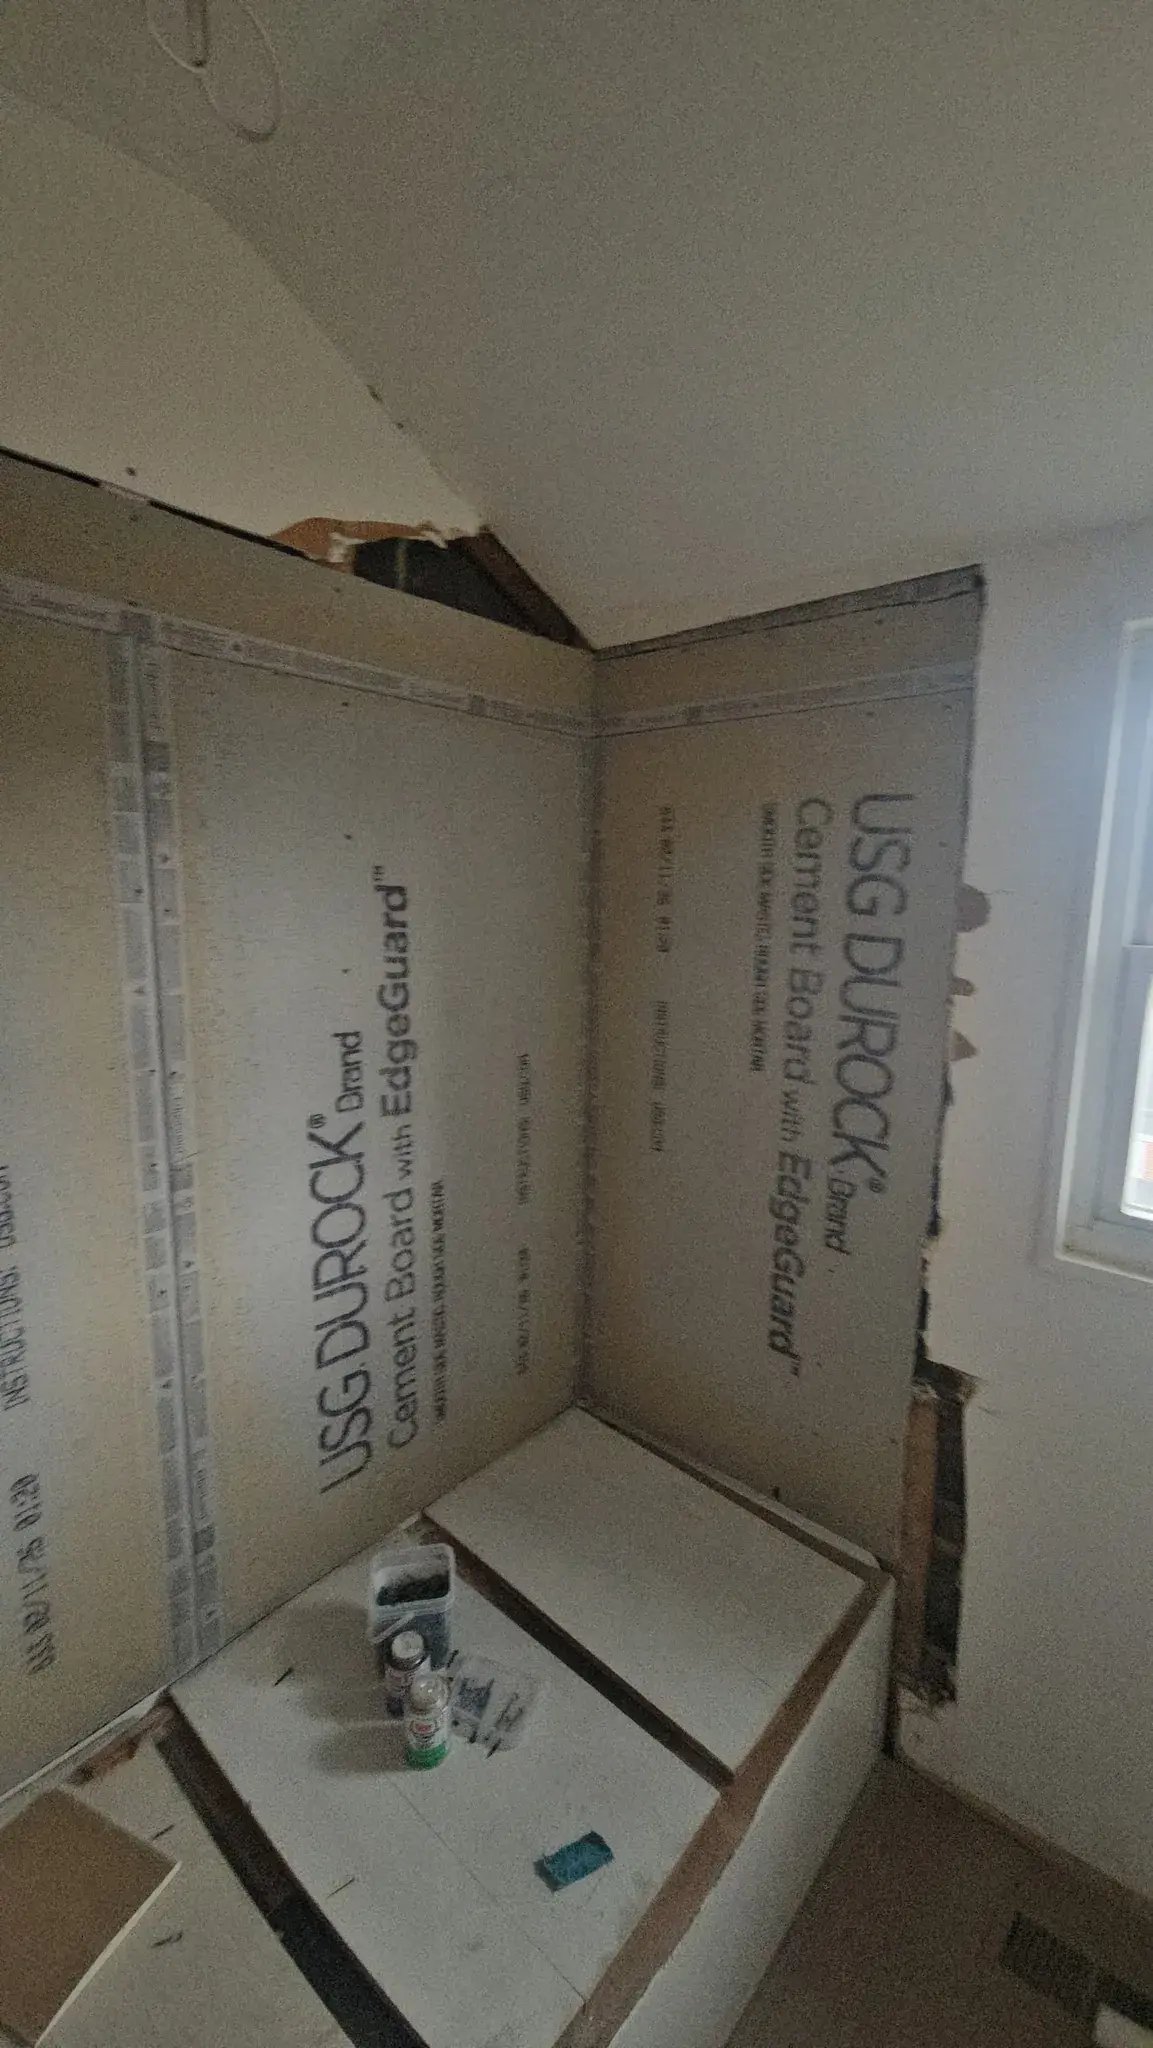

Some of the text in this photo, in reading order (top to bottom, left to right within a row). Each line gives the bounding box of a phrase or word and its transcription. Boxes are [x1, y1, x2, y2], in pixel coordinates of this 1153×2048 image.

[790, 798, 834, 955] Cement
[848, 794, 916, 916] USG
[332, 1030, 364, 1113] Brand
[782, 968, 824, 1085] Board
[392, 1123, 416, 1184] with
[781, 1088, 804, 1143] with
[382, 1187, 416, 1303] Board
[825, 1178, 857, 1255] Brand
[317, 1368, 373, 1494] USG
[386, 1306, 419, 1448] Cement
